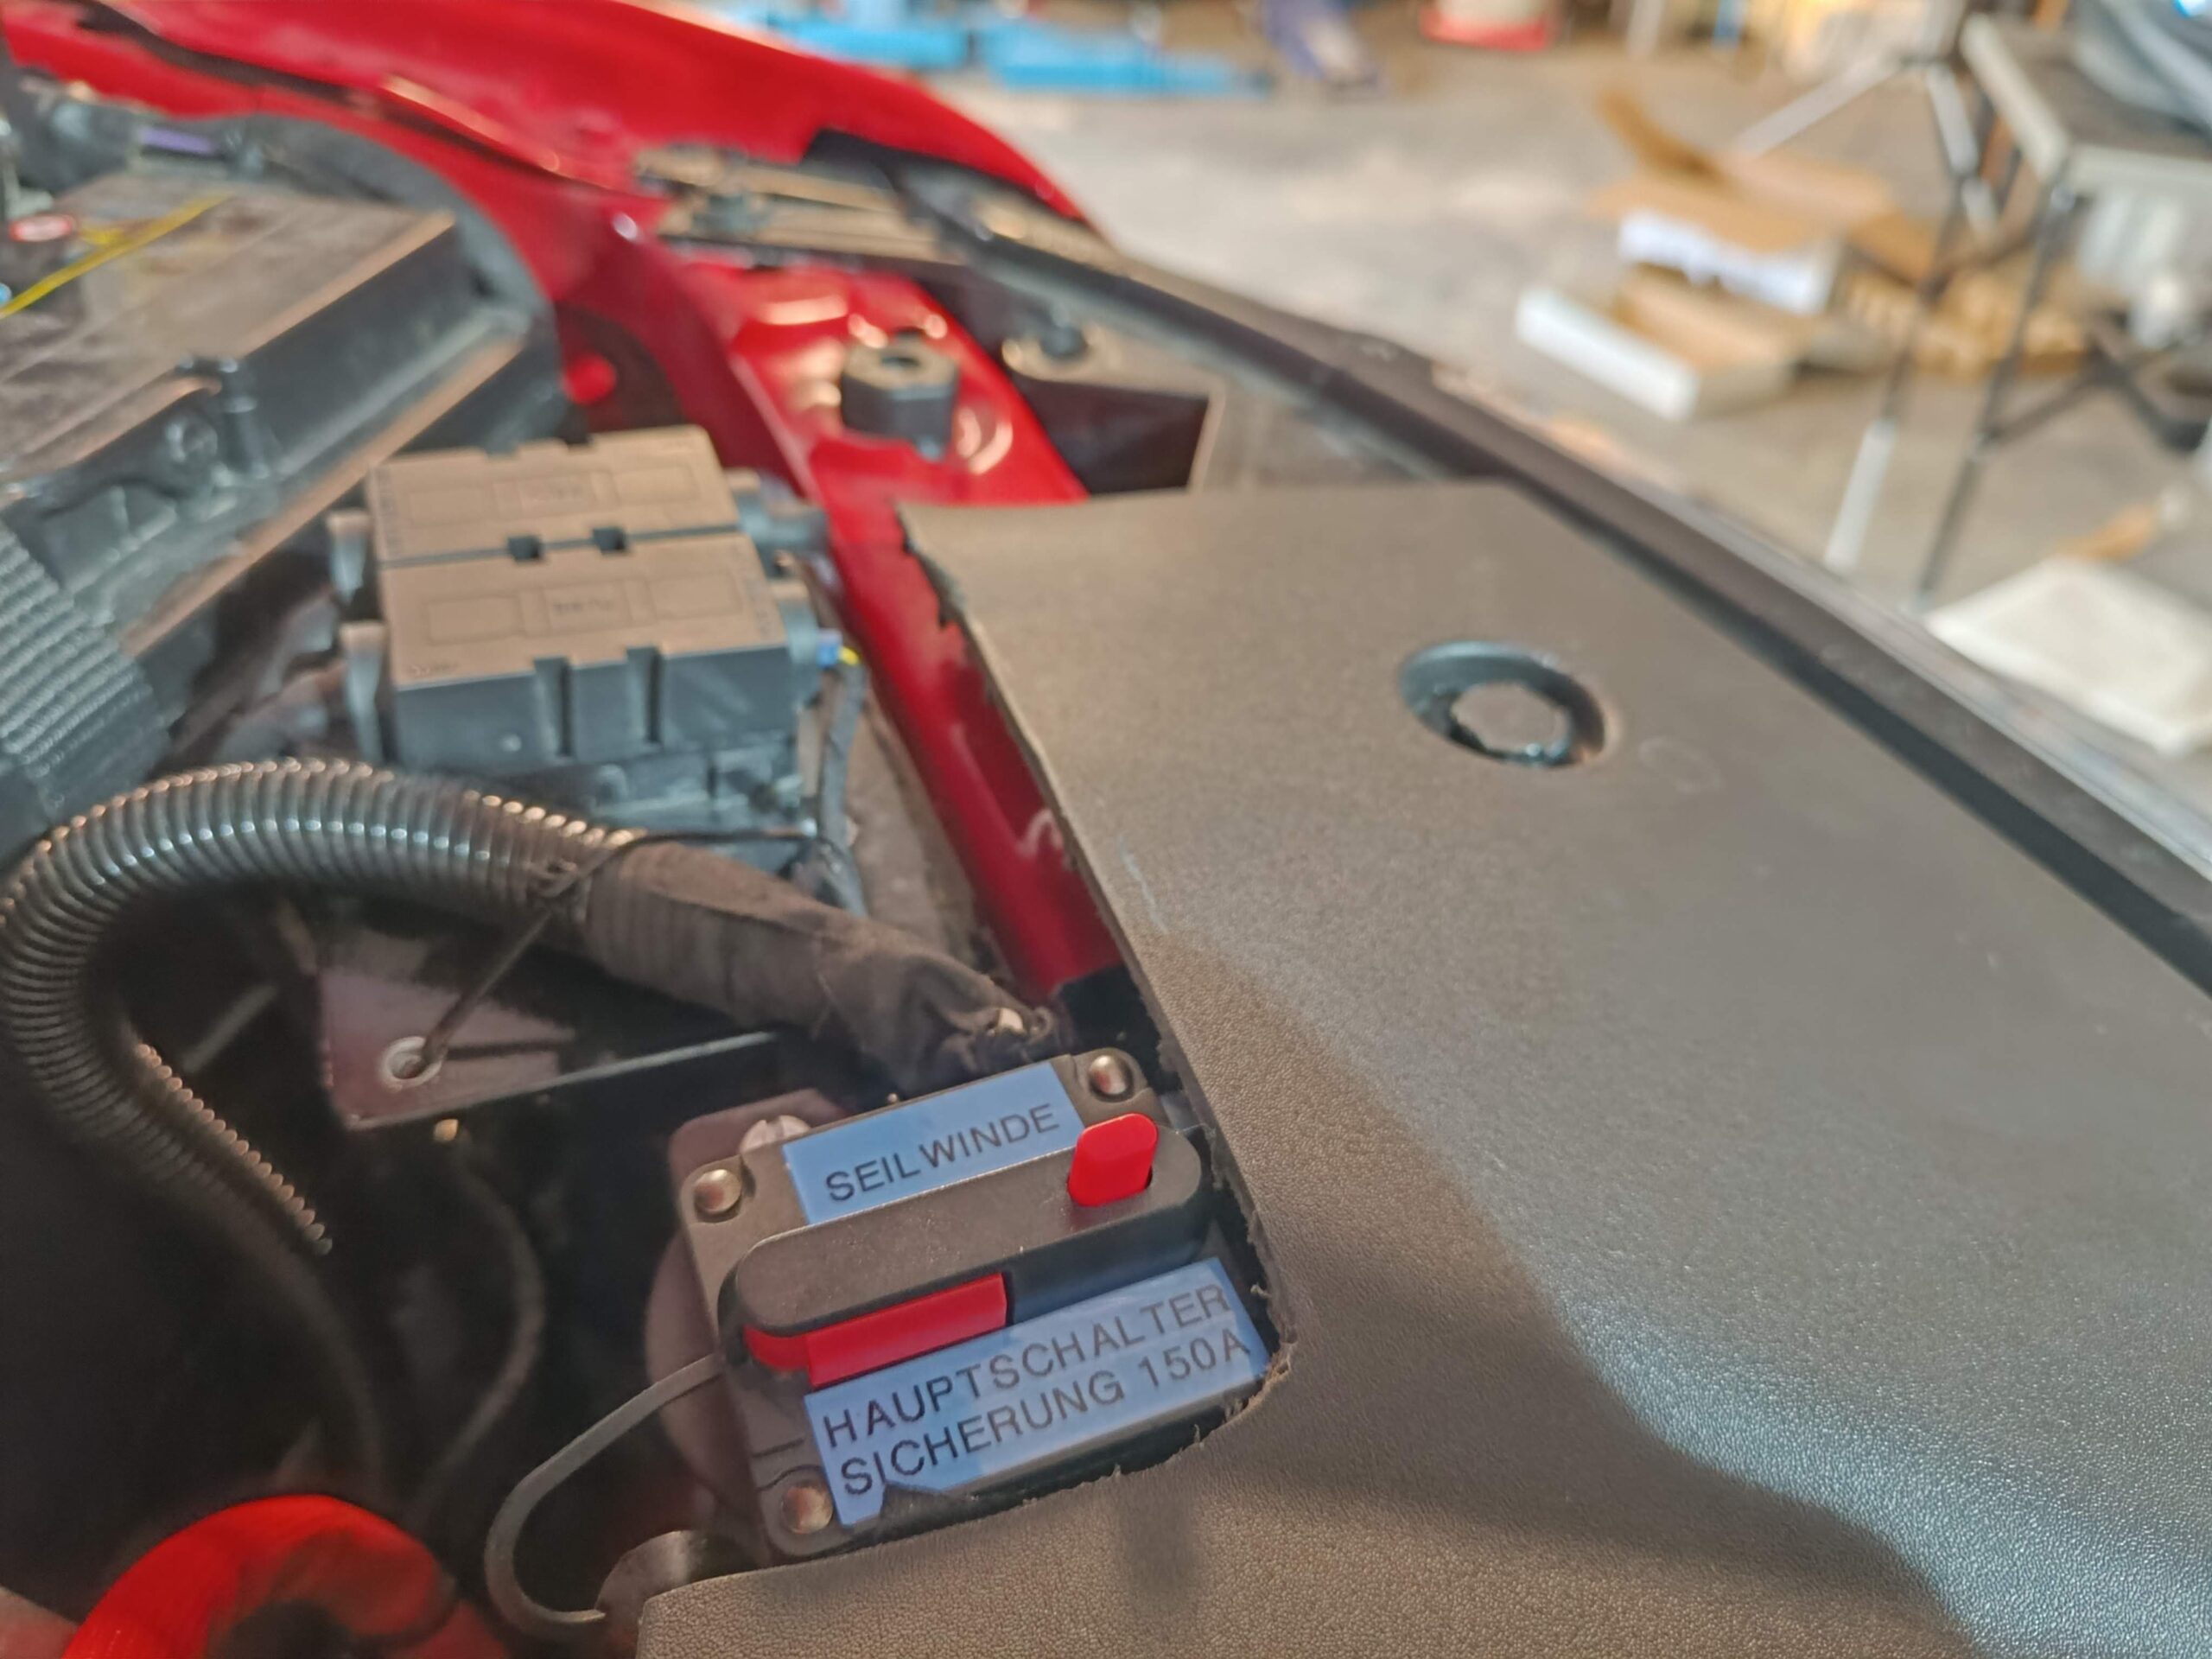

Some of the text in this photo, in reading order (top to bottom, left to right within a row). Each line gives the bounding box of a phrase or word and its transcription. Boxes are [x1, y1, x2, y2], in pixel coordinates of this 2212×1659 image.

[824, 1103, 1059, 1202] SEILWINDE
[823, 1283, 1231, 1448] HAUPTSCHALTER
[841, 1327, 1250, 1495] SICHERUNG 150A
